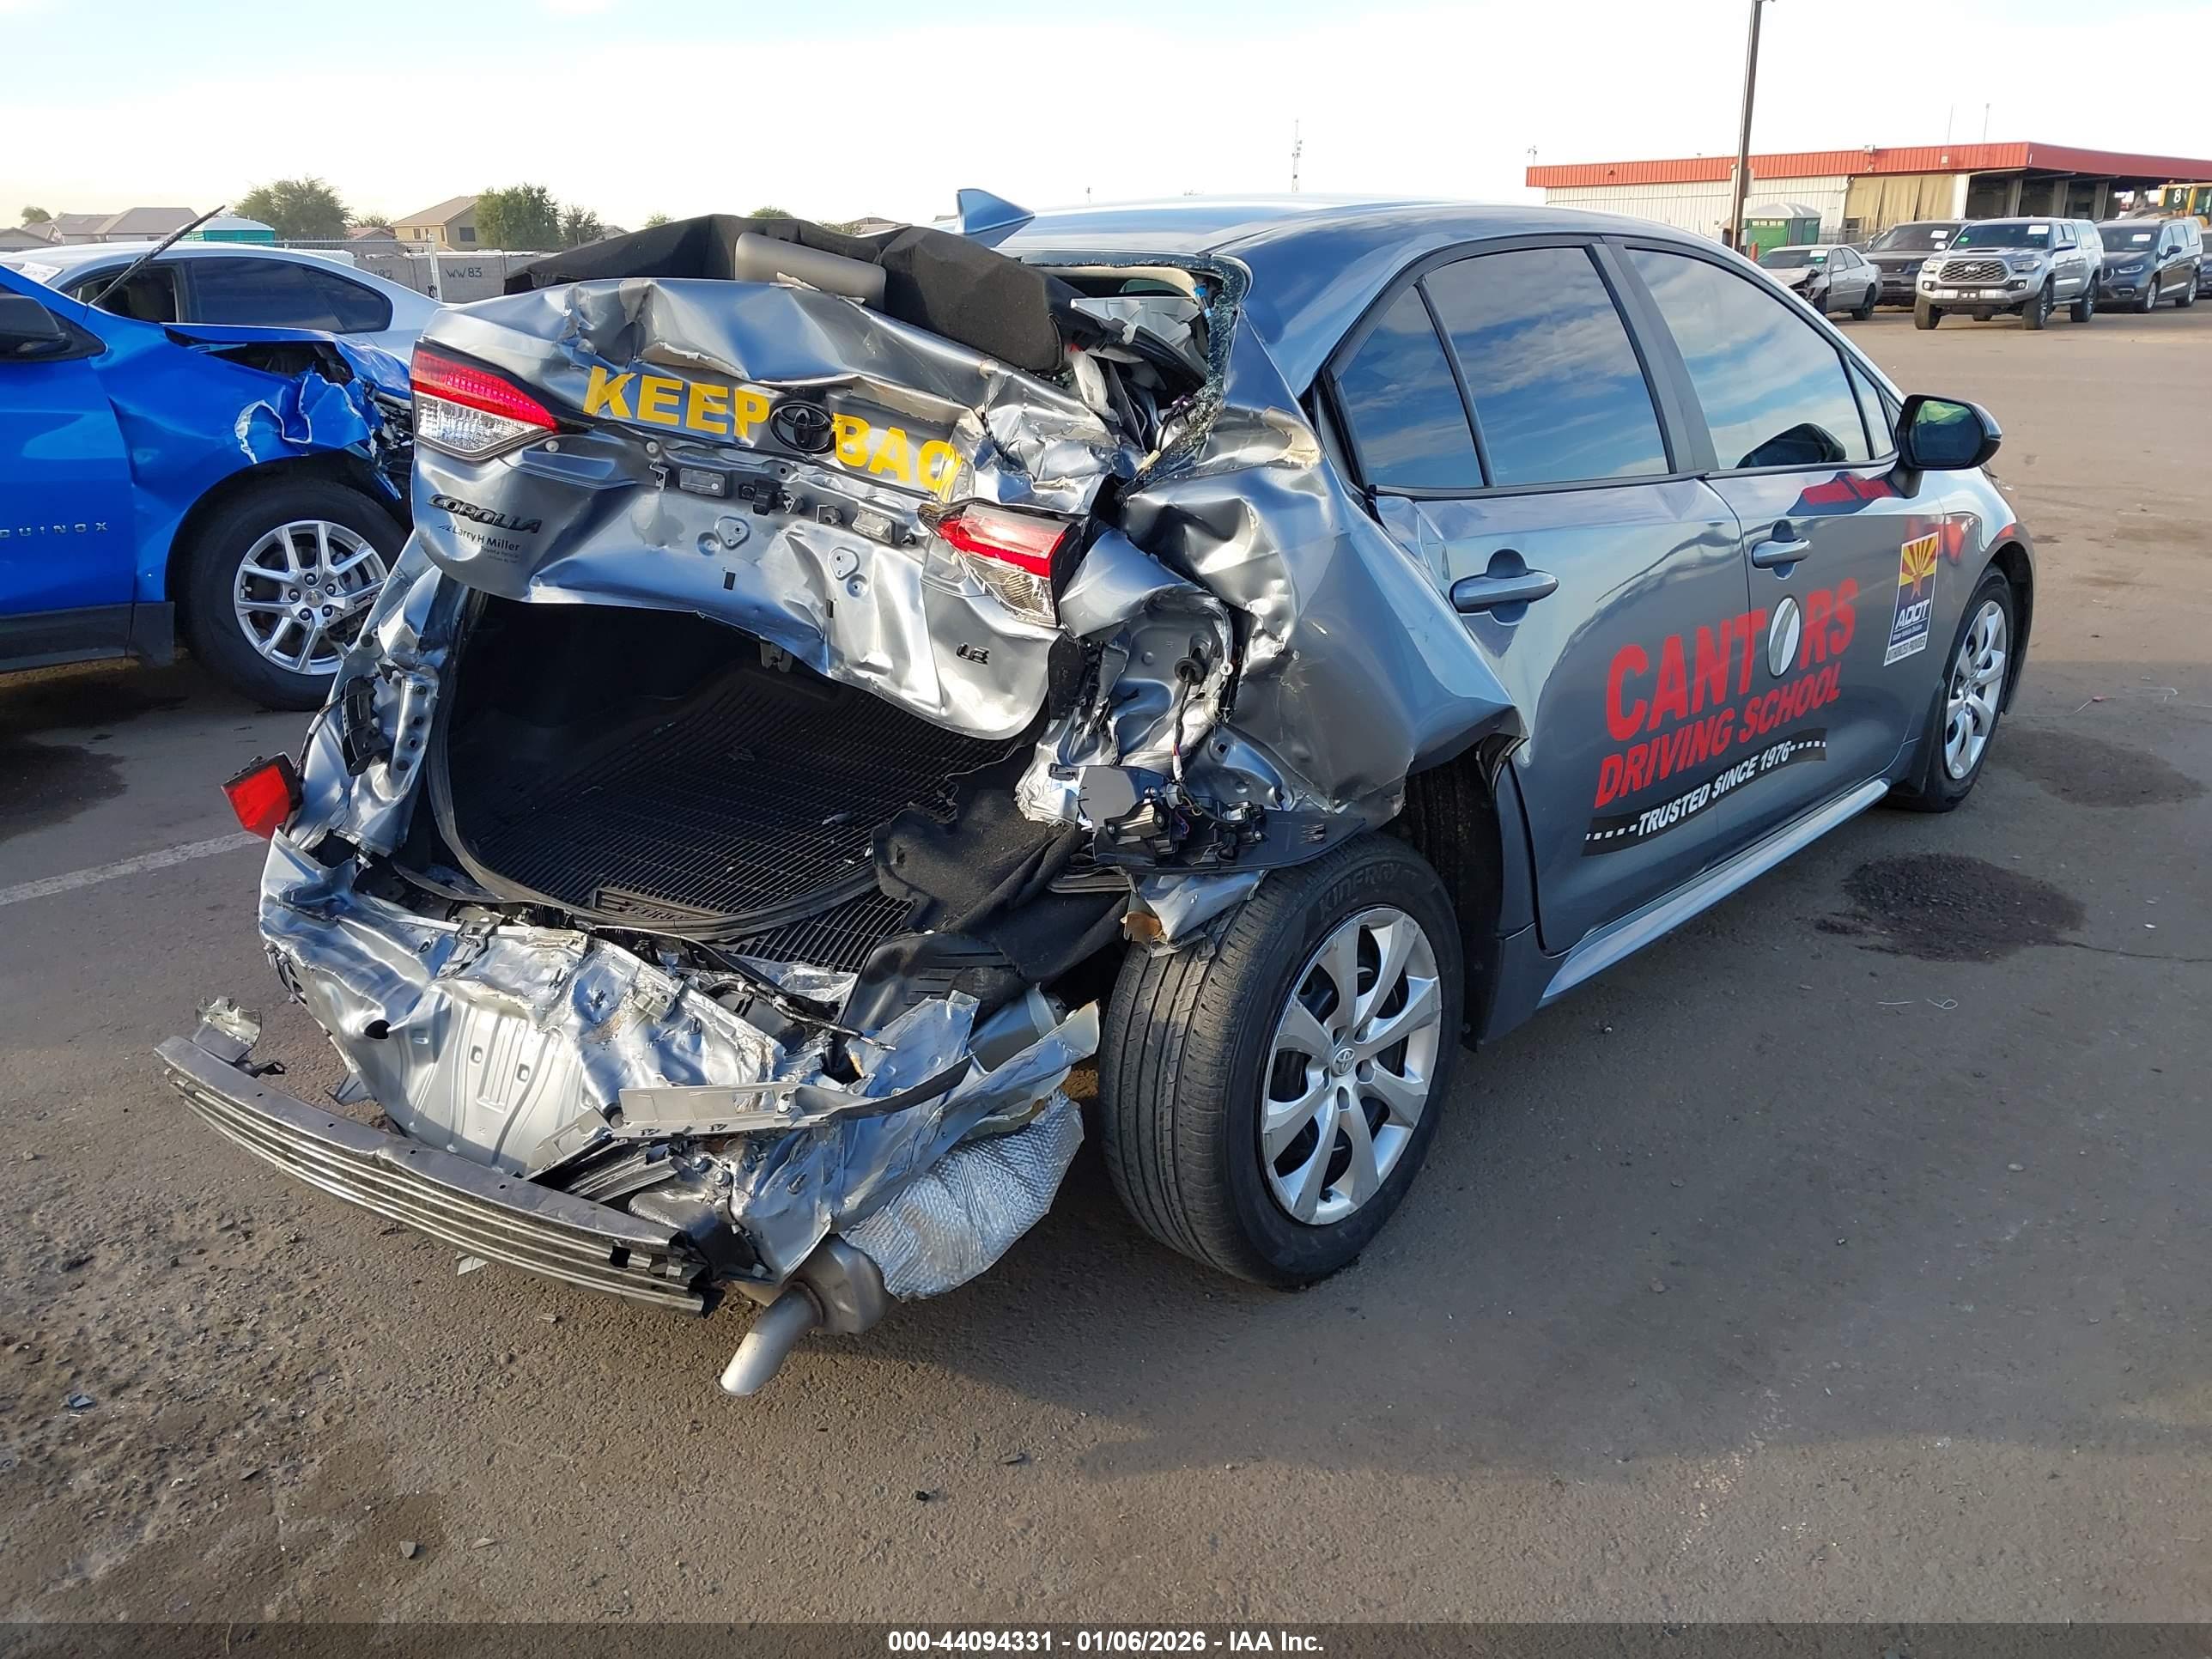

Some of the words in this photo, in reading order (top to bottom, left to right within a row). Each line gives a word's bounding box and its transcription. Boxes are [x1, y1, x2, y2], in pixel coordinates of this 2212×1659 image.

[468, 267, 483, 277] 83
[584, 366, 769, 441] KEEP
[427, 494, 543, 533] COROLLA
[453, 526, 477, 541] Larry
[477, 535, 484, 544] H
[486, 537, 520, 551] Miller
[1894, 599, 1930, 629] ADOT
[956, 643, 989, 665] LE
[1594, 707, 1735, 809] DRIVING
[1738, 661, 1841, 744] SCHOOL
[1638, 783, 1711, 836] TRUSTED
[1711, 754, 1759, 799] SINCE
[1760, 740, 1791, 771] 1976
